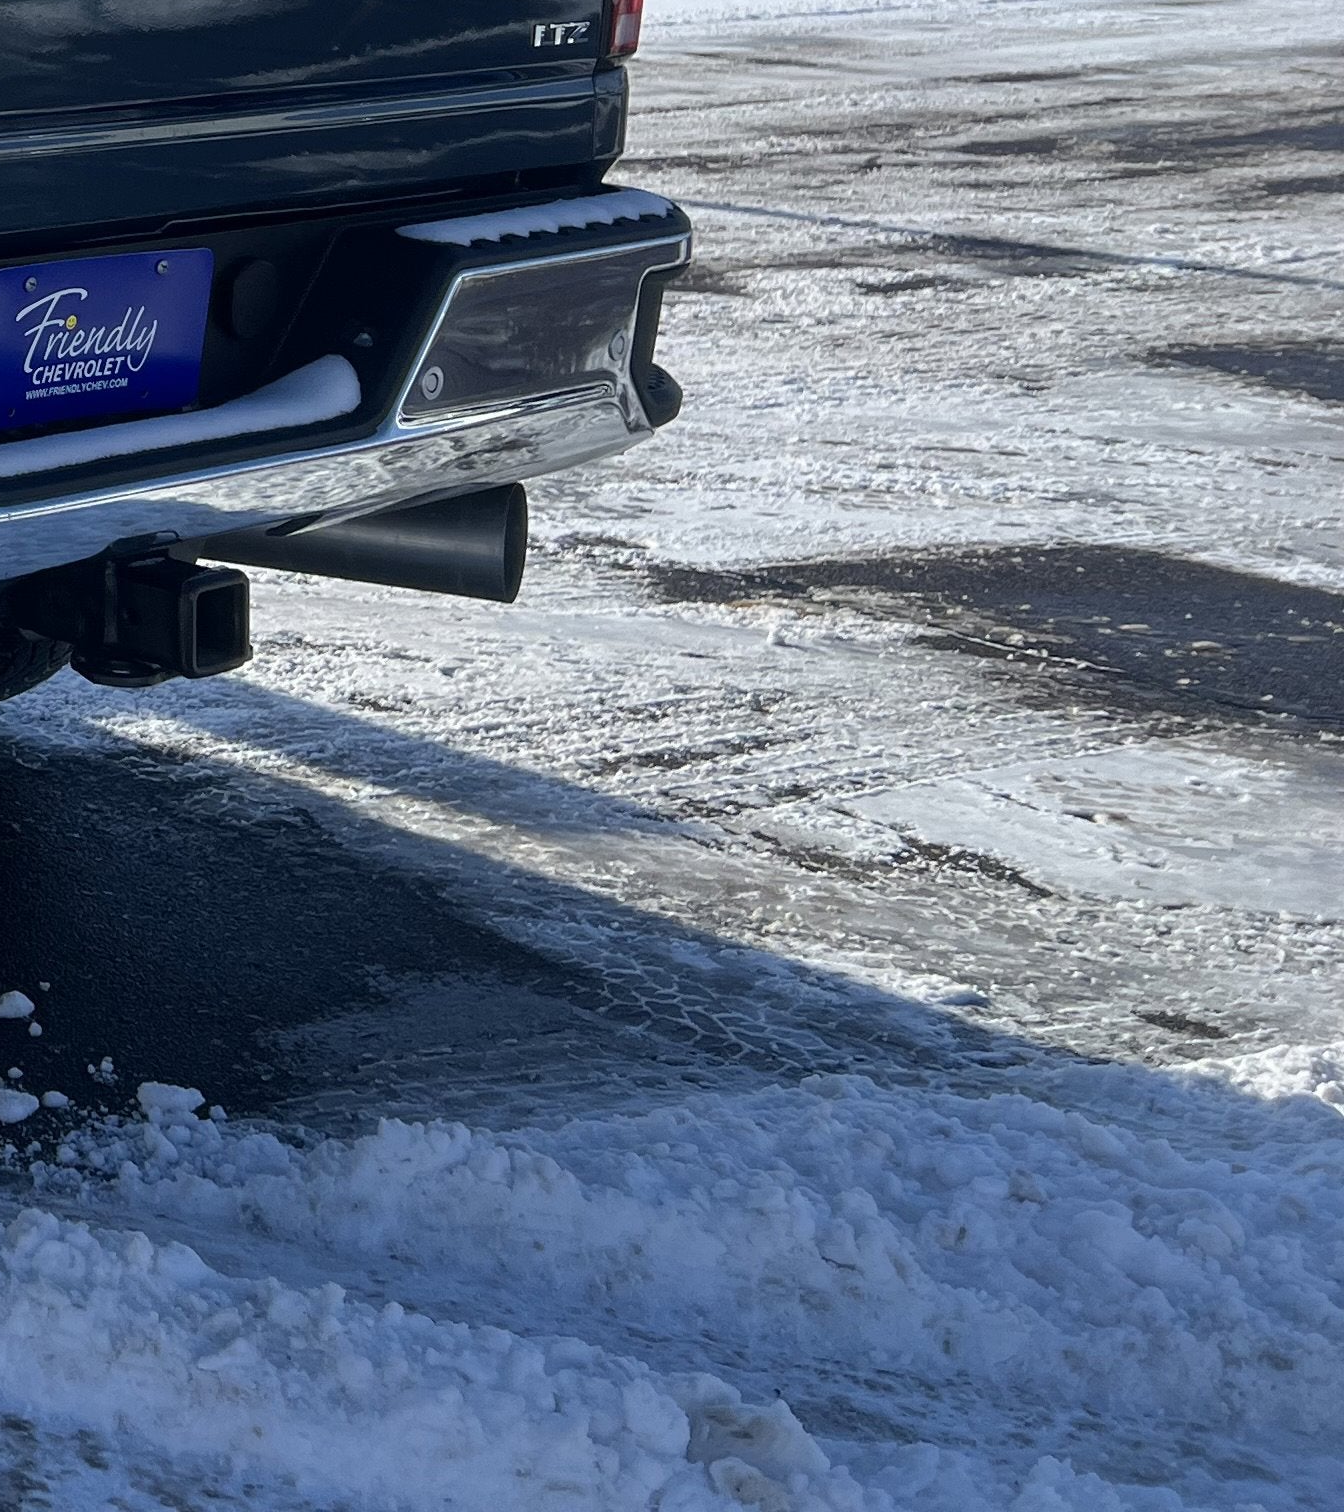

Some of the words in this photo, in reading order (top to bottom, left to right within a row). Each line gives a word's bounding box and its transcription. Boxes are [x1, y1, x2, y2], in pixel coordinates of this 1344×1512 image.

[15, 288, 158, 374] Friendly
[32, 356, 125, 385] CHEVROLET
[25, 378, 129, 400] WWW.FRIENDLYCHEV.COM
